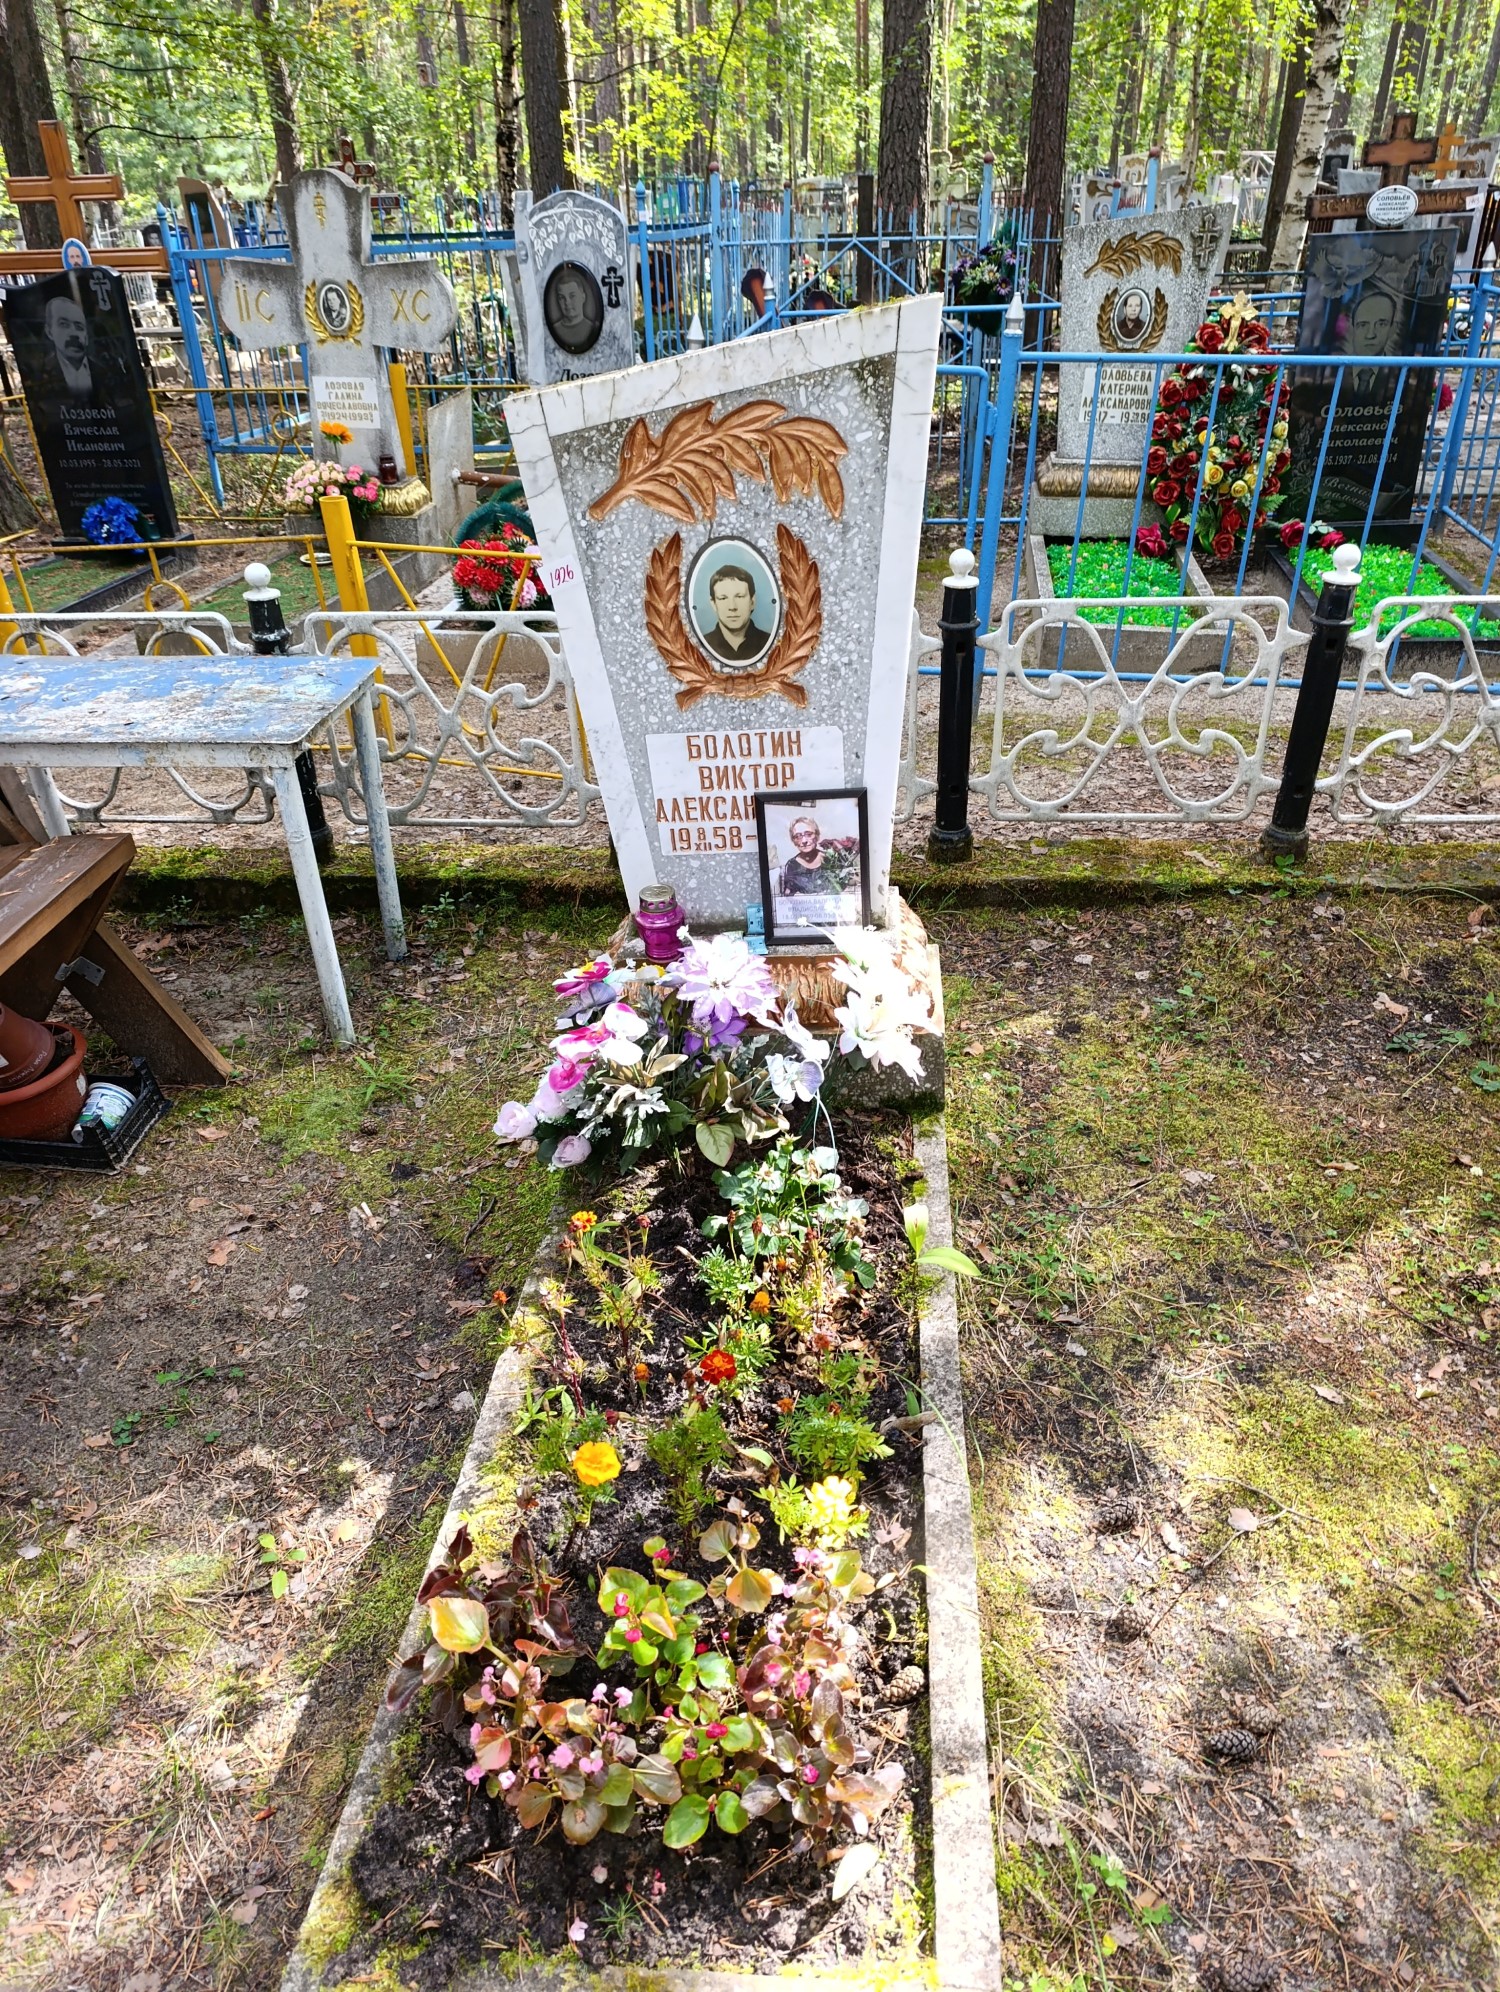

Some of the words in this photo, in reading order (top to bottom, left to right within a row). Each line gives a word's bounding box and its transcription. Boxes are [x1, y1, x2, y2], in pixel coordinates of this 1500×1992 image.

[1376, 194, 1411, 202] СОЛОВЬЁВ
[1101, 369, 1152, 382] ОЛОВЬЕВА
[324, 381, 365, 391] ЛОЗОВАЯ
[1099, 383, 1149, 396] КАТЕРИНА
[328, 391, 363, 401] ГАЛИНА
[1082, 396, 1153, 411] АЛКСАНДРОВН
[59, 405, 117, 420] Лозовой
[63, 423, 120, 436] Вячеслав
[1322, 419, 1397, 433] лександ
[65, 439, 126, 452] Иванович
[1316, 436, 1399, 448] иколаевч
[1356, 453, 1398, 465] 31.08.14
[1322, 477, 1371, 497] Вечна
[685, 730, 803, 762] БОЛОТИН
[698, 762, 796, 793] ВИКТОР
